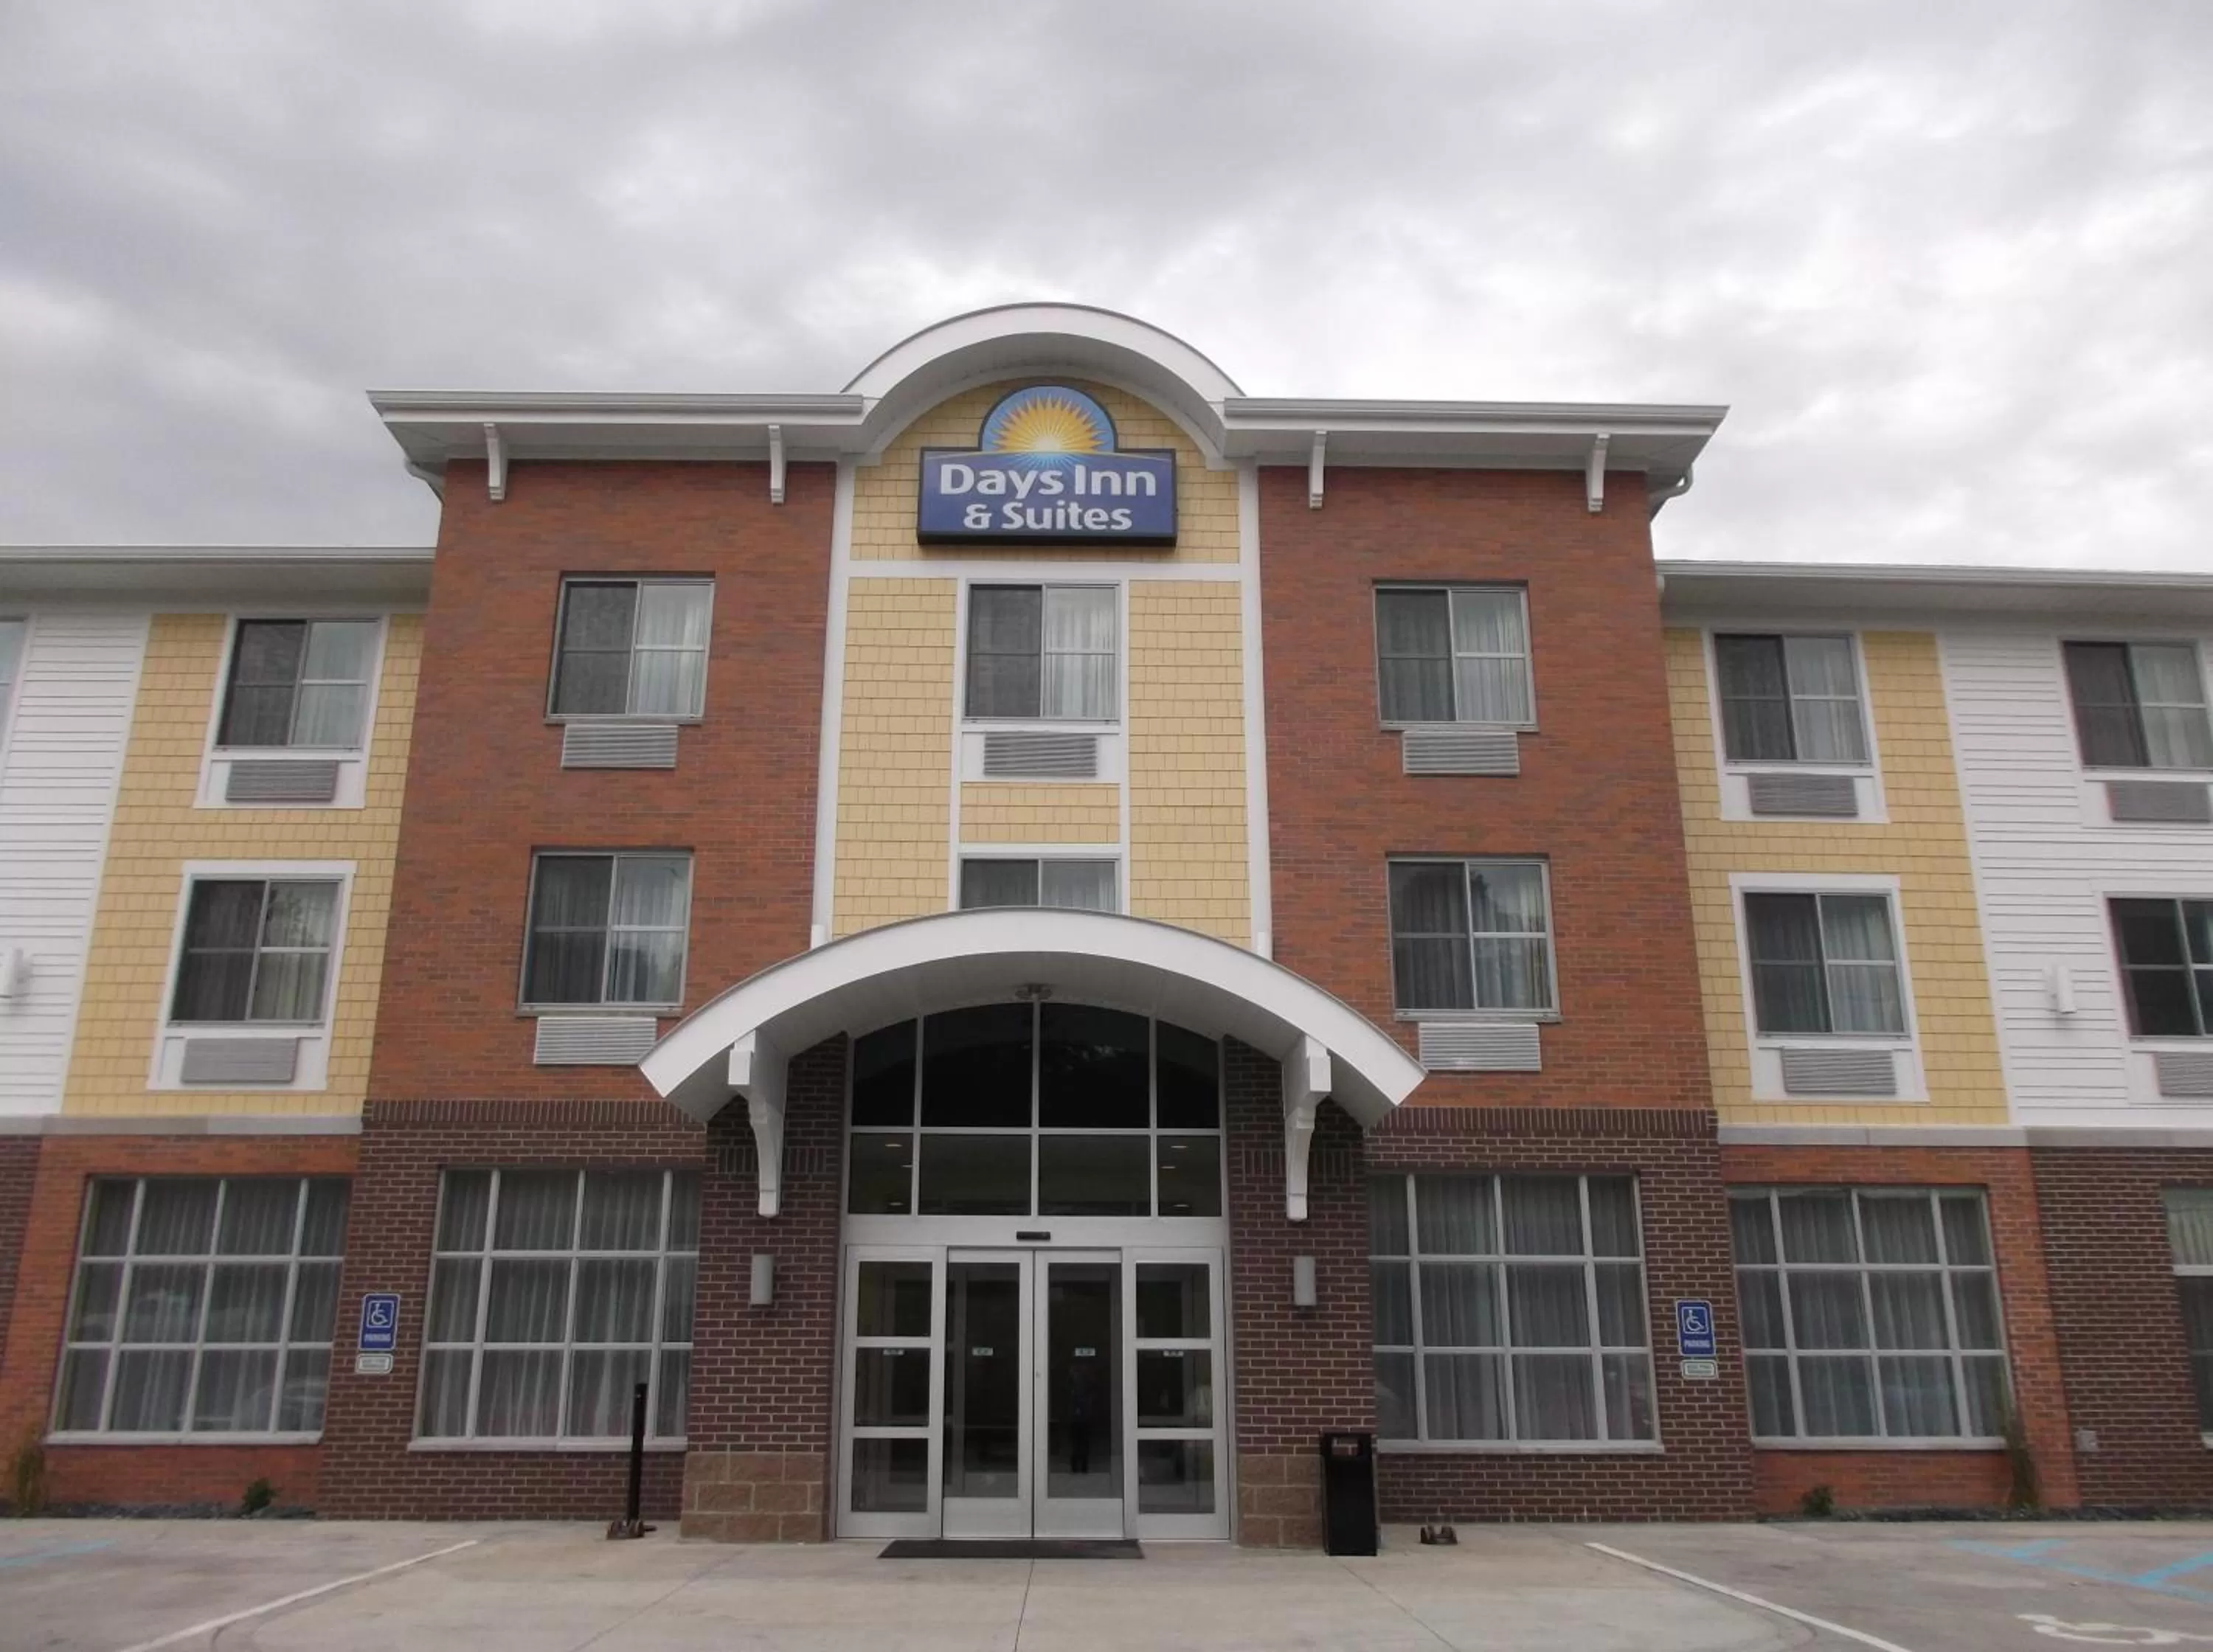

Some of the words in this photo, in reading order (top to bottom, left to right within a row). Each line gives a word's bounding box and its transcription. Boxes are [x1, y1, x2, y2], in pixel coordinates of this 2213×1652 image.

[941, 464, 1064, 499] Days
[1075, 465, 1157, 496] Inn
[963, 503, 992, 530] &
[1002, 500, 1132, 530] Suites
